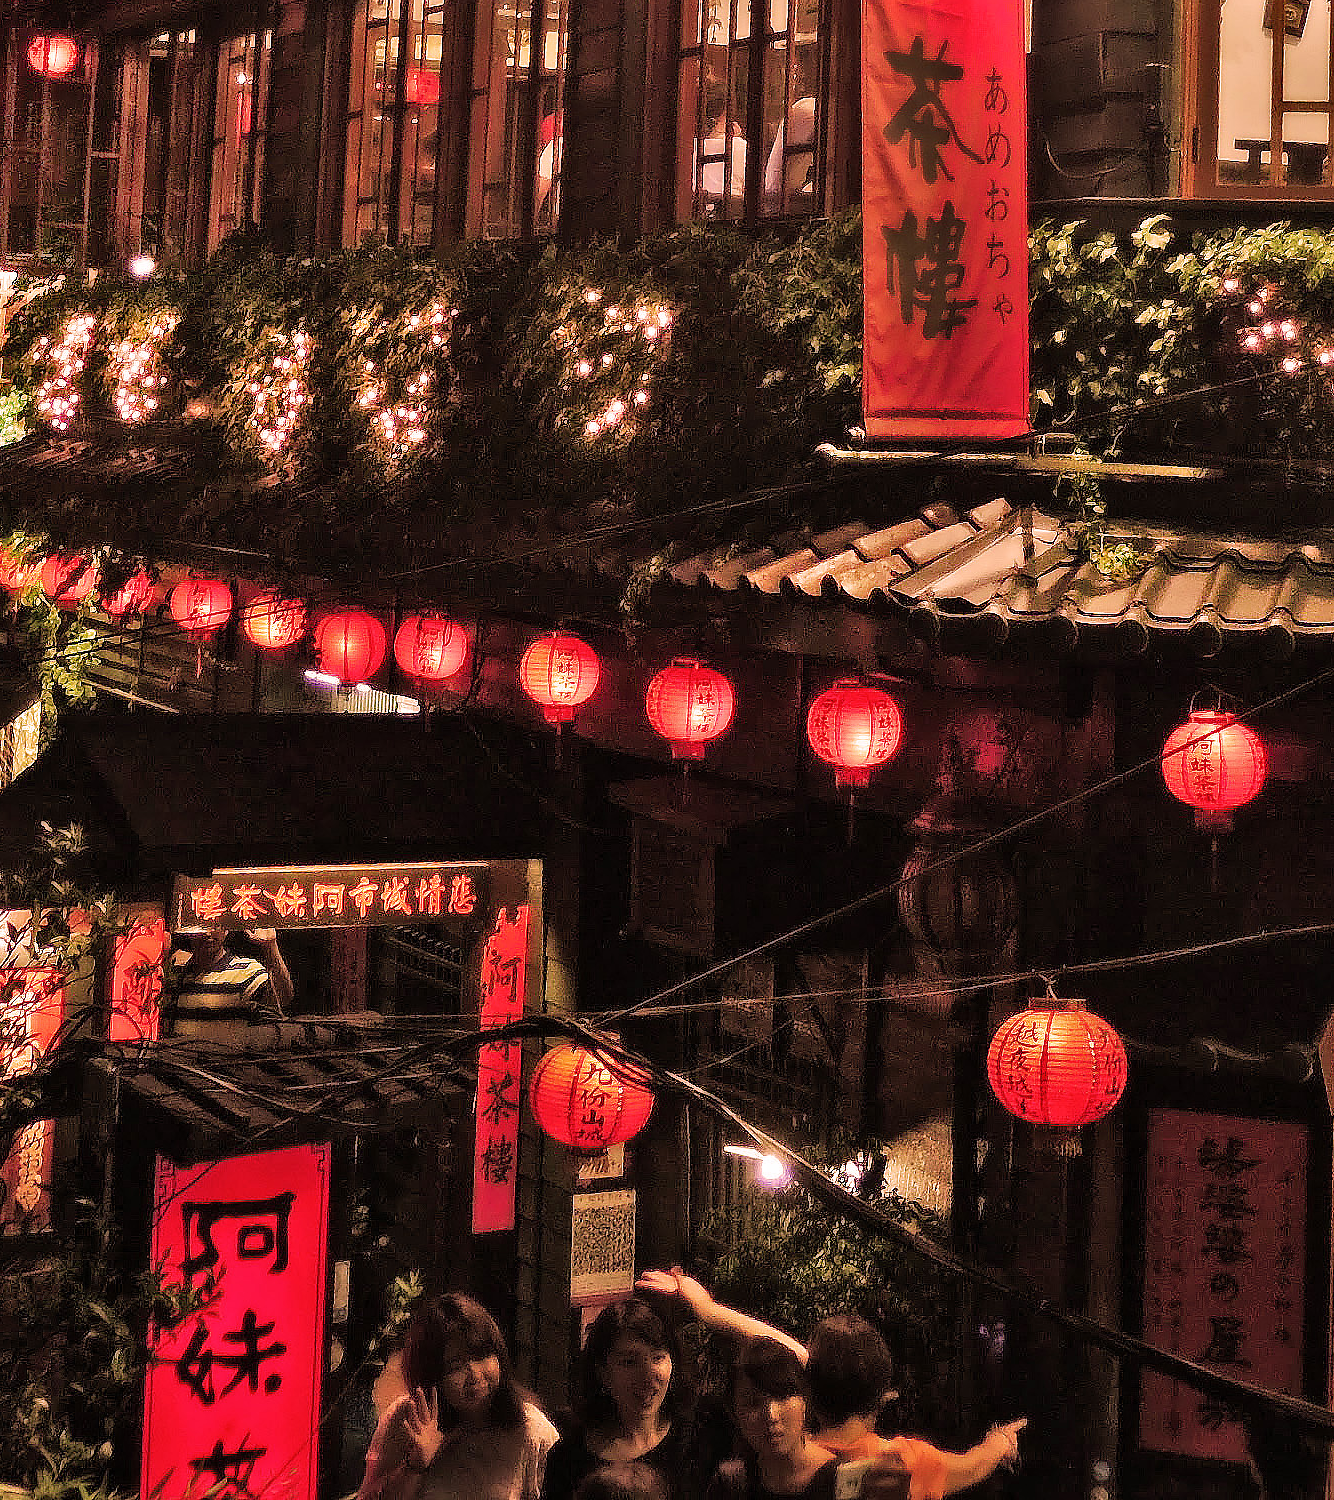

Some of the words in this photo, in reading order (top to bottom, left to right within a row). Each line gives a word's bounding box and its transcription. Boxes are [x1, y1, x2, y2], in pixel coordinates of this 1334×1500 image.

[983, 67, 1014, 325] あめおちゃ
